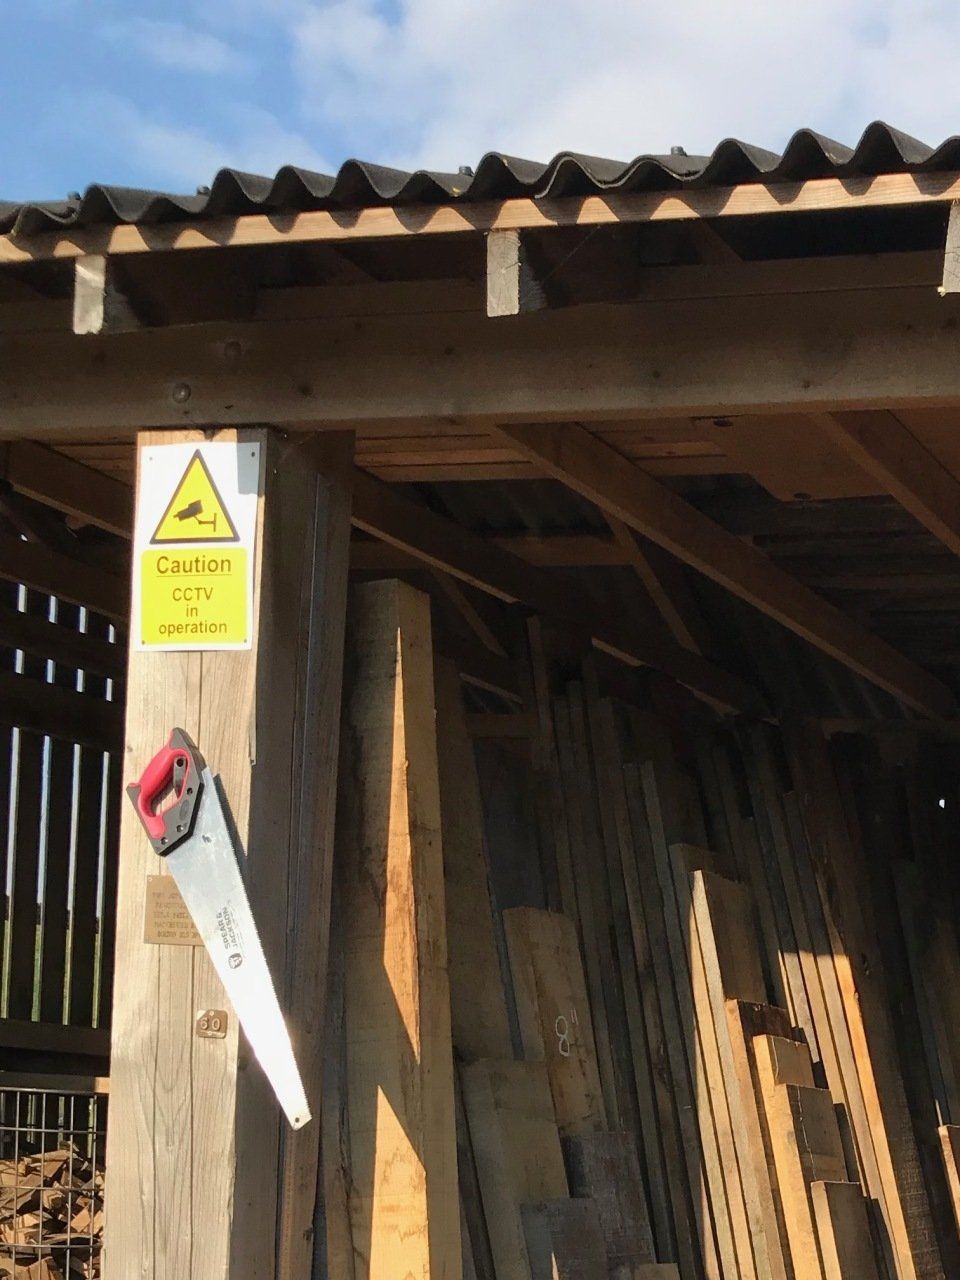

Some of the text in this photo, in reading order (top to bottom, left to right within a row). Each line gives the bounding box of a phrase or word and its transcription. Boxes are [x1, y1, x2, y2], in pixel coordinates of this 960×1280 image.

[156, 554, 232, 574] Caution
[172, 587, 214, 602] CCTV
[186, 604, 199, 618] in
[158, 620, 228, 637] operation
[200, 1017, 221, 1031] 60
